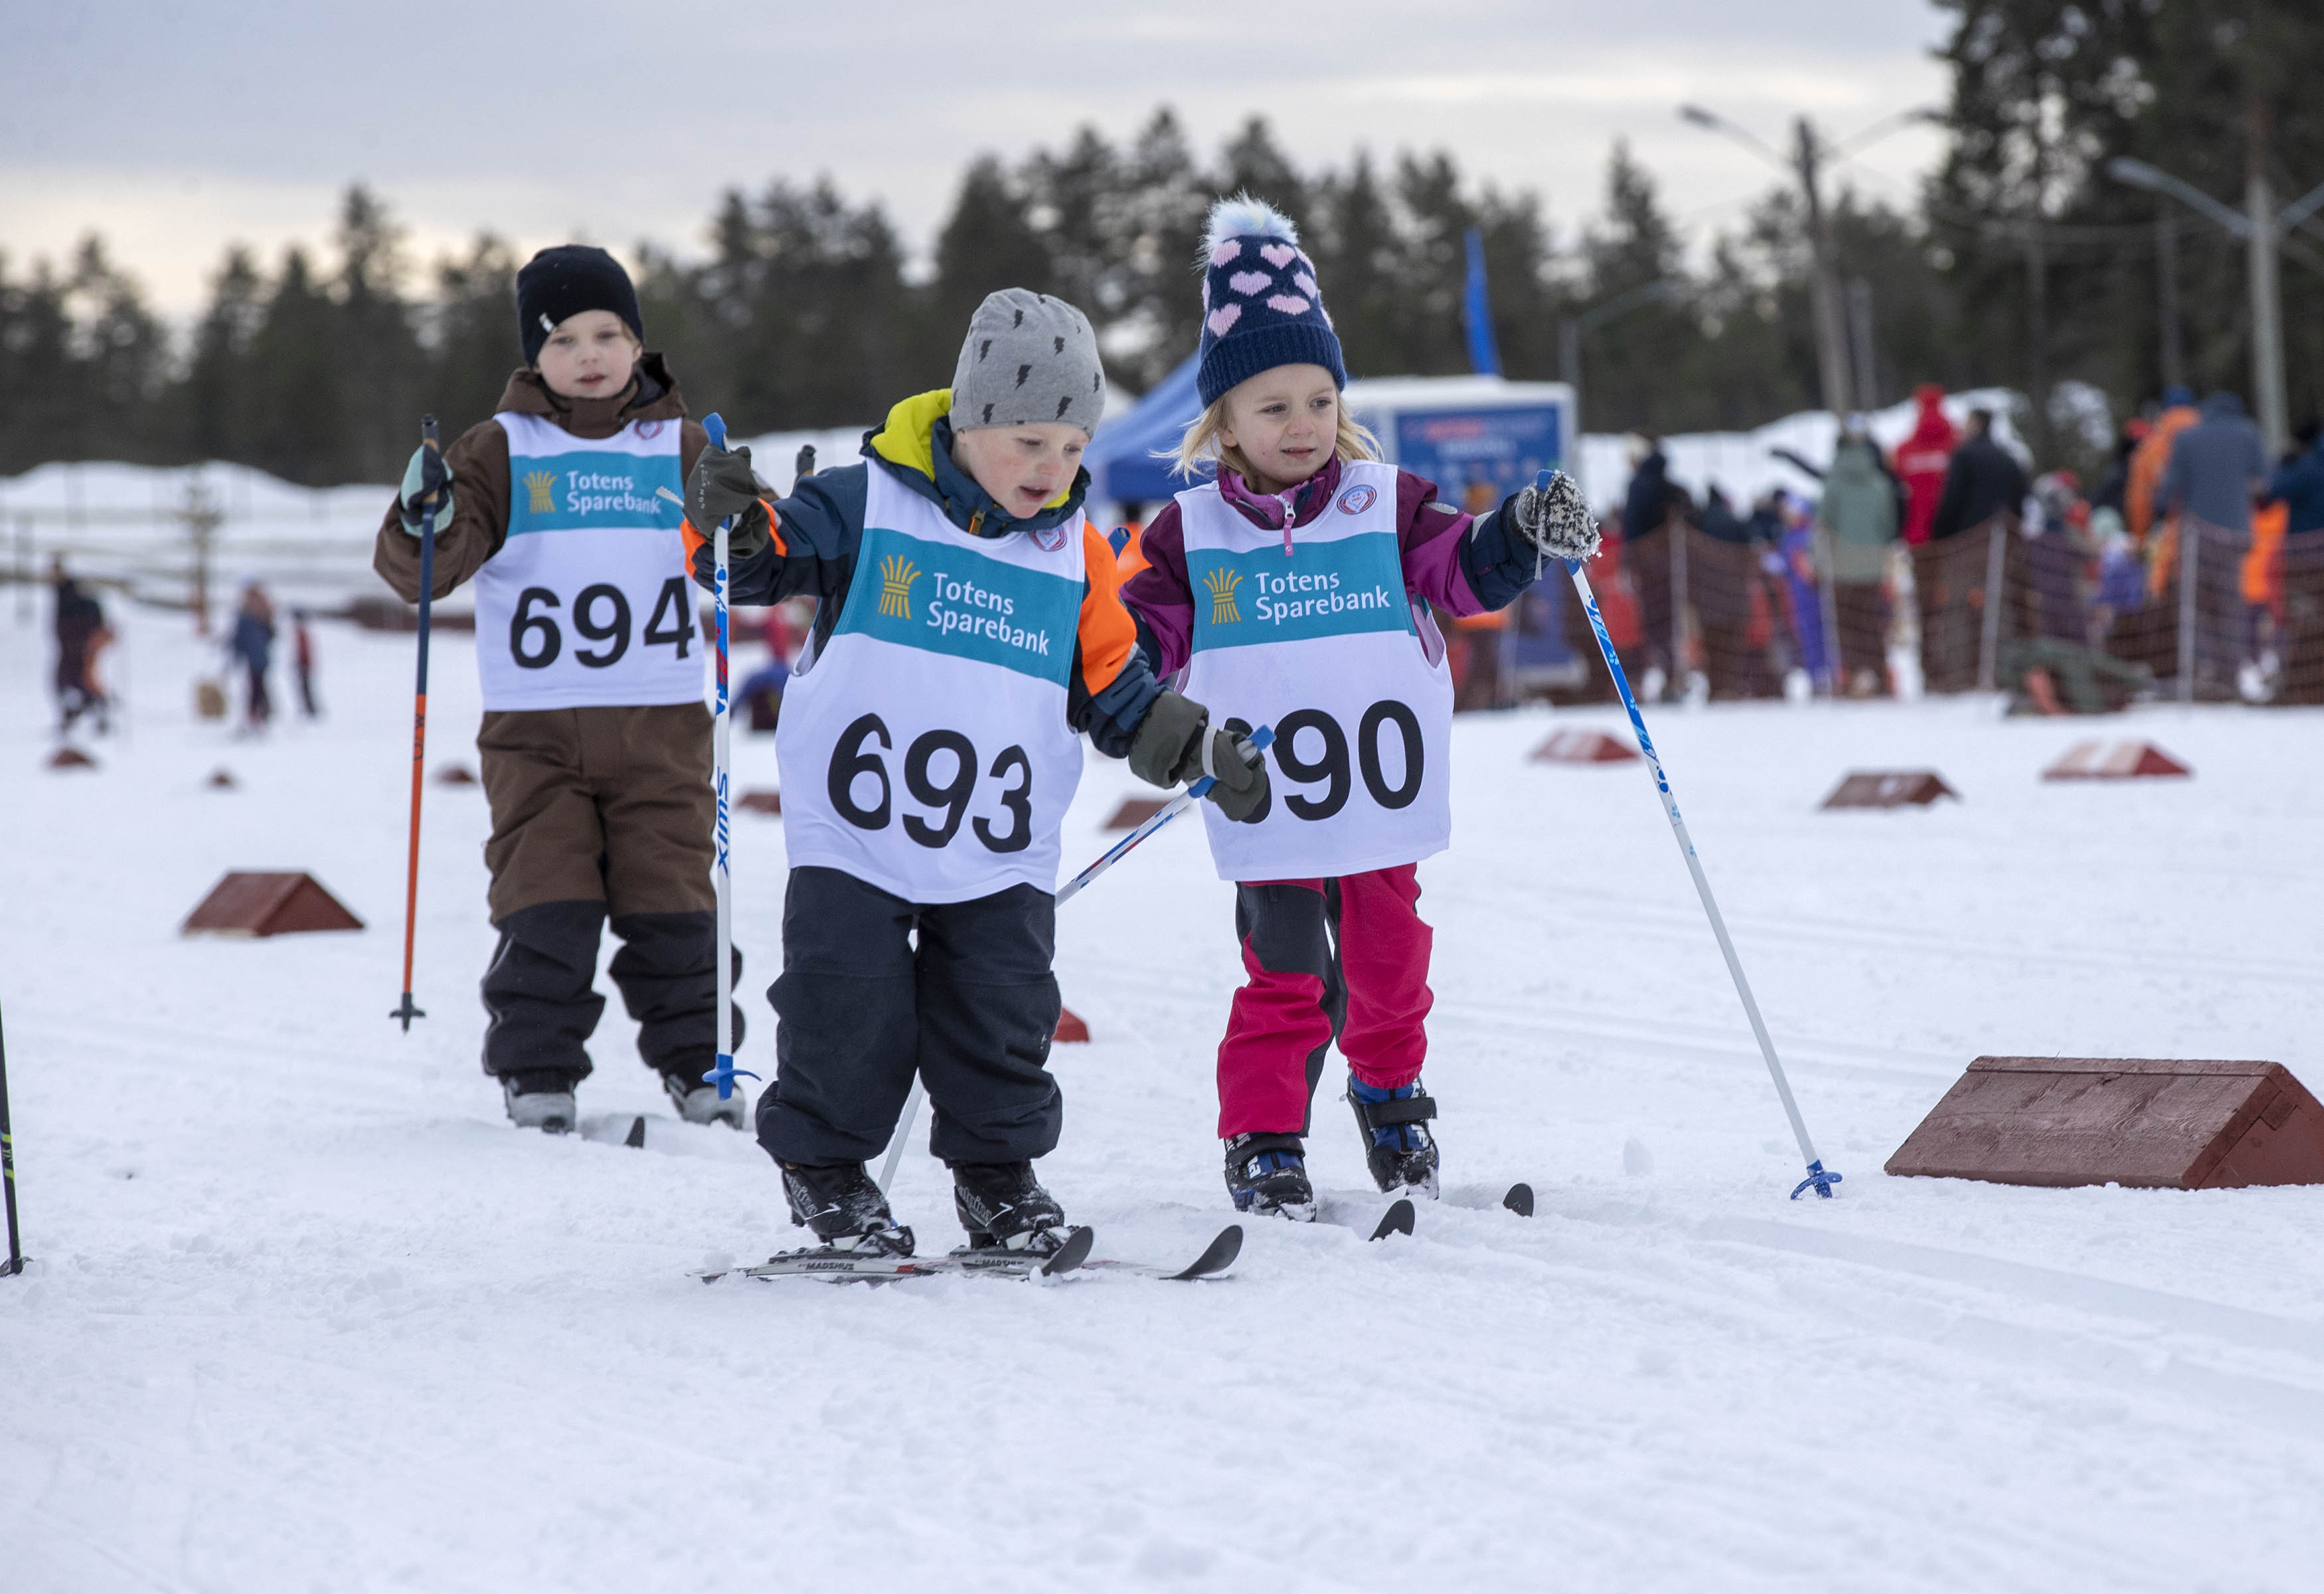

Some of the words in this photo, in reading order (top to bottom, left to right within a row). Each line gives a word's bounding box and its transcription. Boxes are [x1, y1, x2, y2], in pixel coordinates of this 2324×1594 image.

[566, 470, 633, 490] Totens
[567, 491, 662, 515] Sparebank
[932, 572, 1015, 615] Totens
[1255, 571, 1340, 594] Totens
[510, 575, 695, 669] 694
[1256, 585, 1390, 625] Sparebank
[926, 601, 1050, 656] Sparebank
[827, 712, 1033, 853] 693
[717, 766, 728, 877] SWIX
